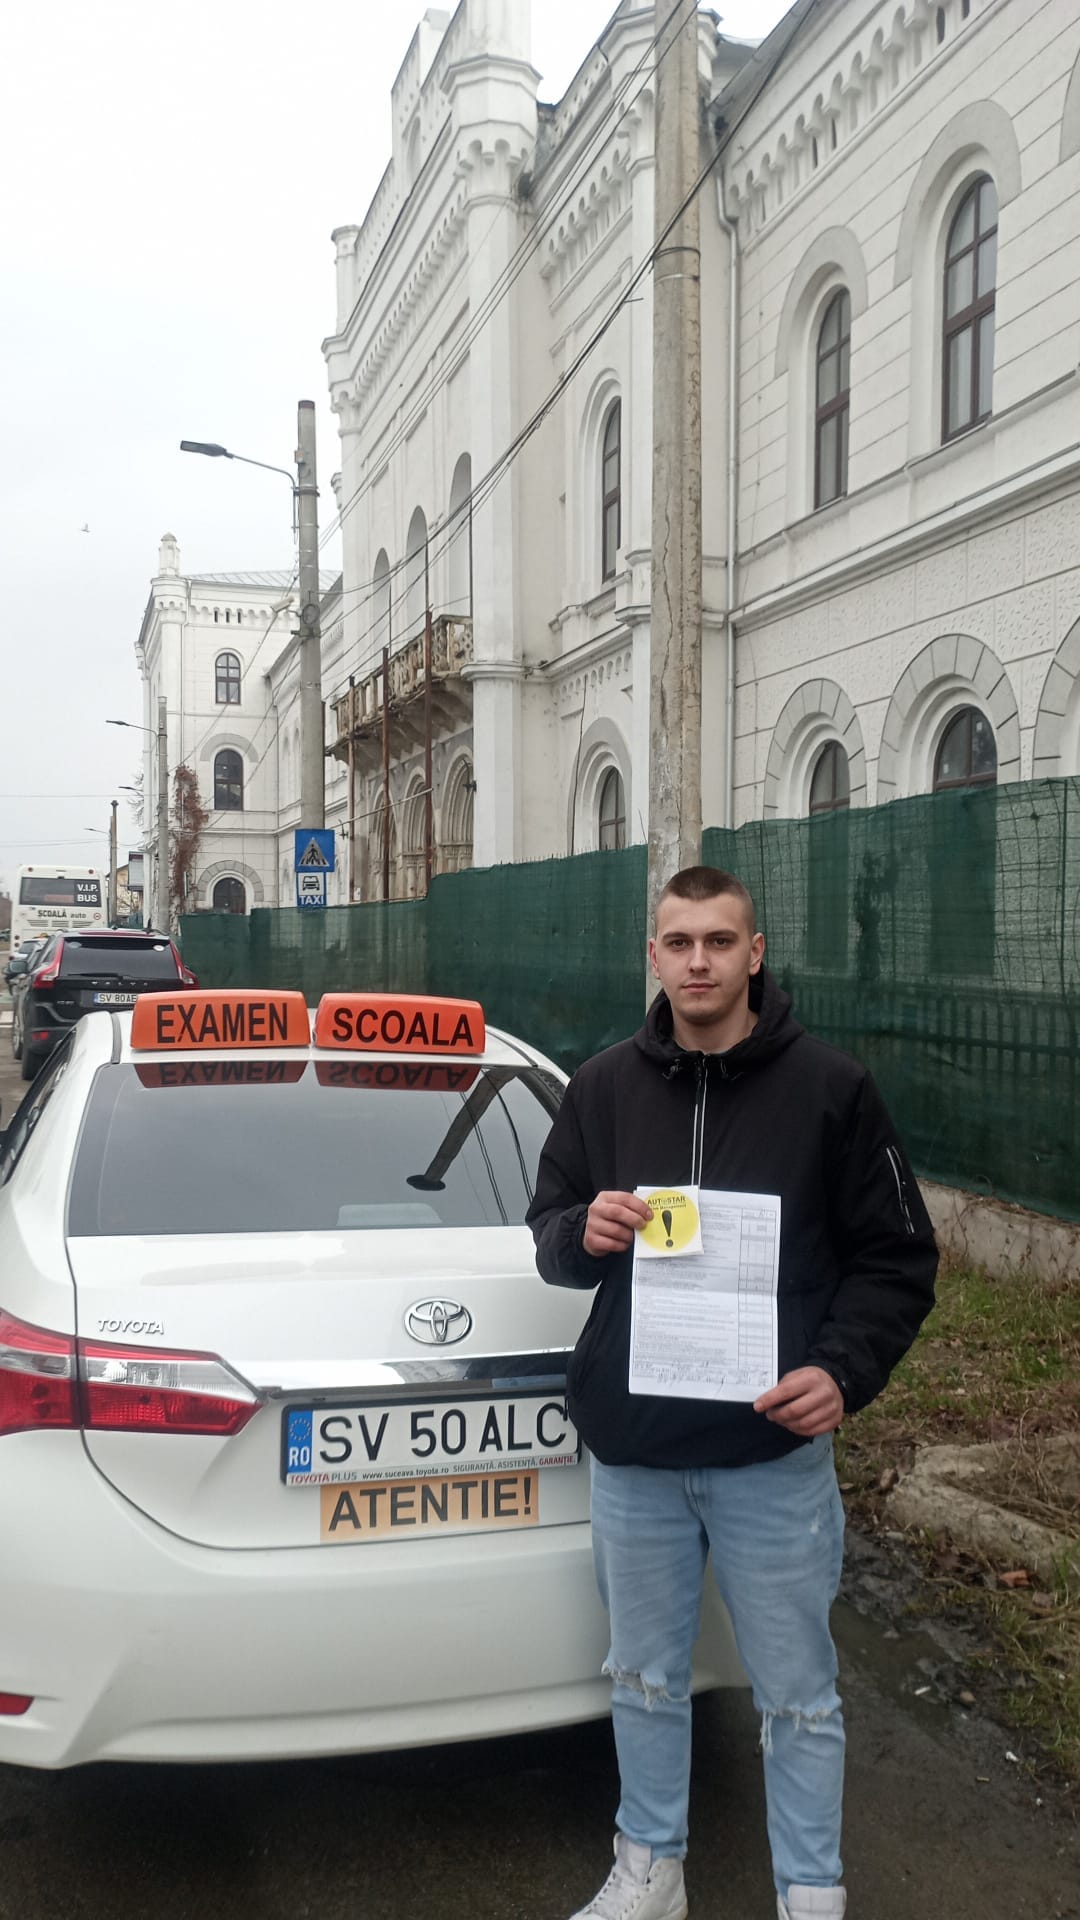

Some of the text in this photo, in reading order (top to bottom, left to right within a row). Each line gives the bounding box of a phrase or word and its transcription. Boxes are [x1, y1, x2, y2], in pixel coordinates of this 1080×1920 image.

[77, 884, 99, 892] V.I.P.
[77, 894, 98, 903] BUS
[299, 895, 324, 905] TAXI
[156, 1002, 288, 1043] EXAMEN
[332, 1008, 474, 1047] SCOALA
[98, 1319, 165, 1335] TOYOTA
[319, 1402, 568, 1464] SV 50 ALC
[288, 1446, 311, 1468] RO
[290, 1473, 330, 1485] TOYOTA
[331, 1471, 358, 1482] PLUS
[362, 1467, 450, 1481] www.suceava.toyota.ro
[328, 1476, 532, 1532] ATENTIE!
